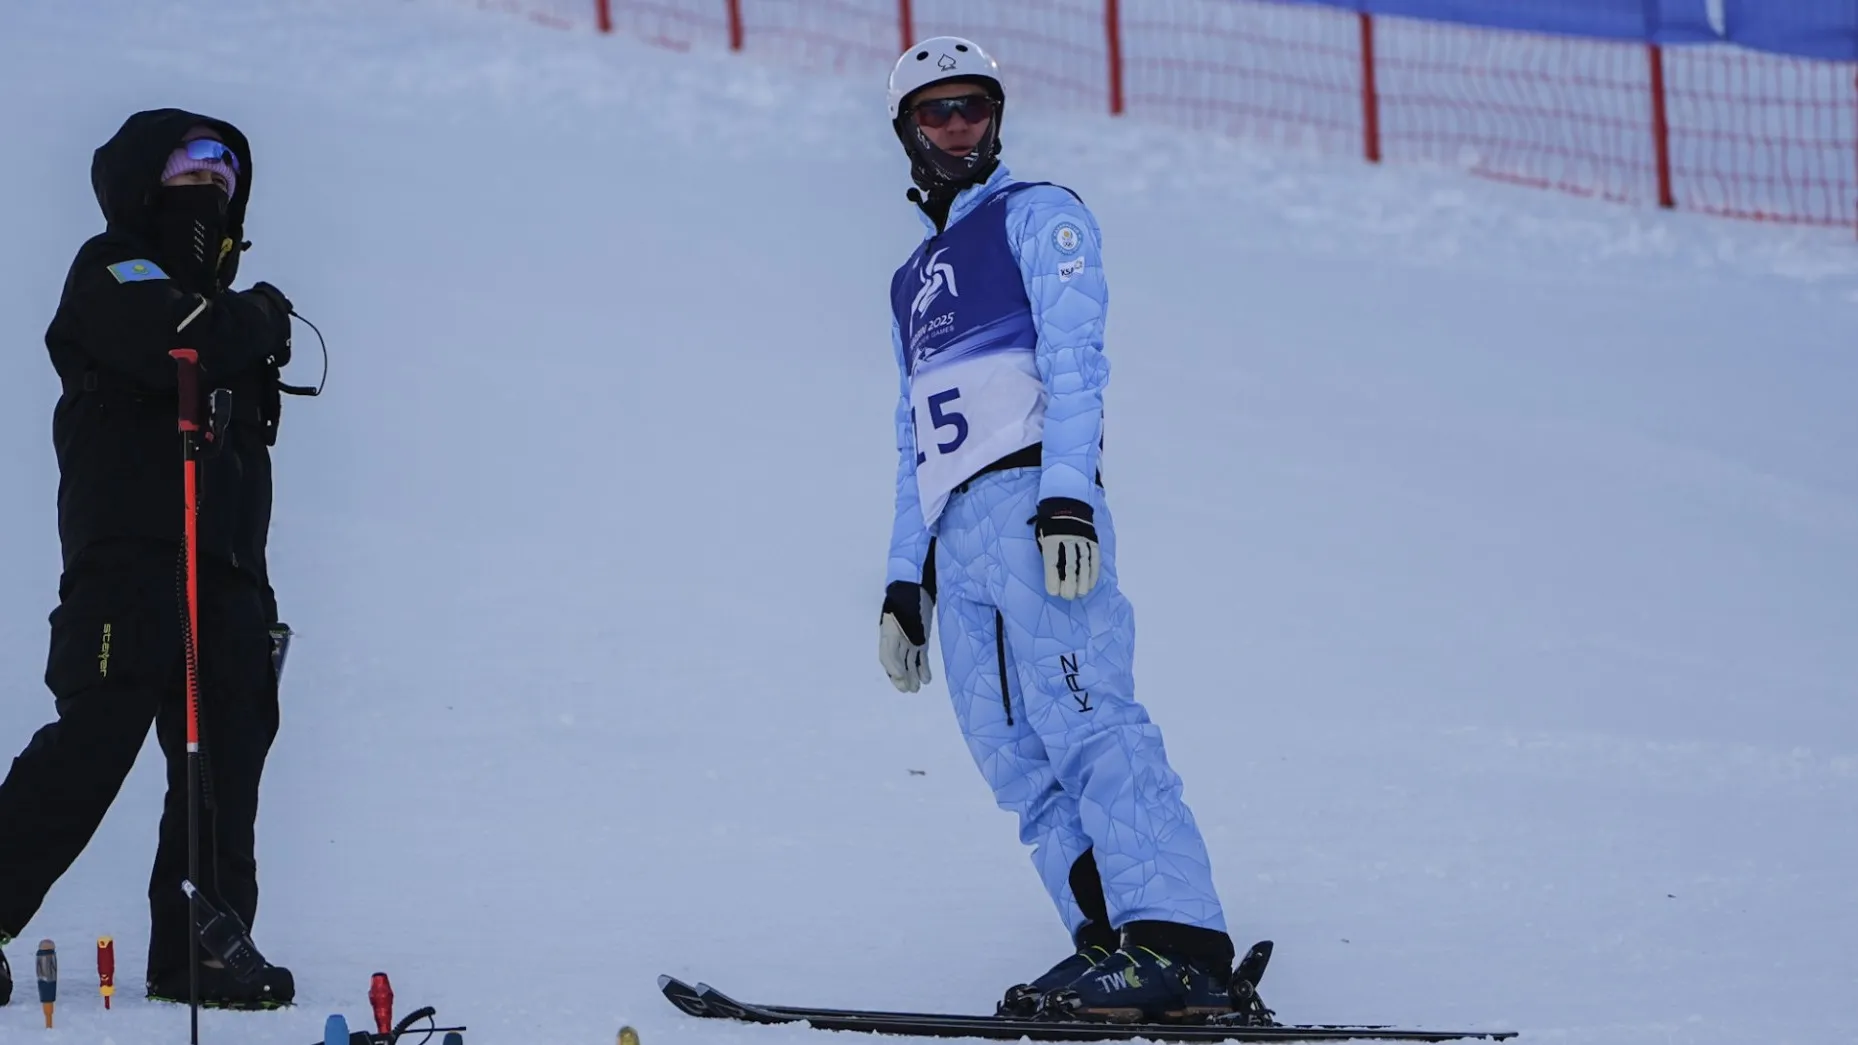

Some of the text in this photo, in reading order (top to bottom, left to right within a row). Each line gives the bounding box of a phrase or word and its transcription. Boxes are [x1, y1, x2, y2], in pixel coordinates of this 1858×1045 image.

[928, 312, 955, 331] 2025
[98, 623, 111, 678] stayer
[1060, 652, 1094, 713] KAZ
